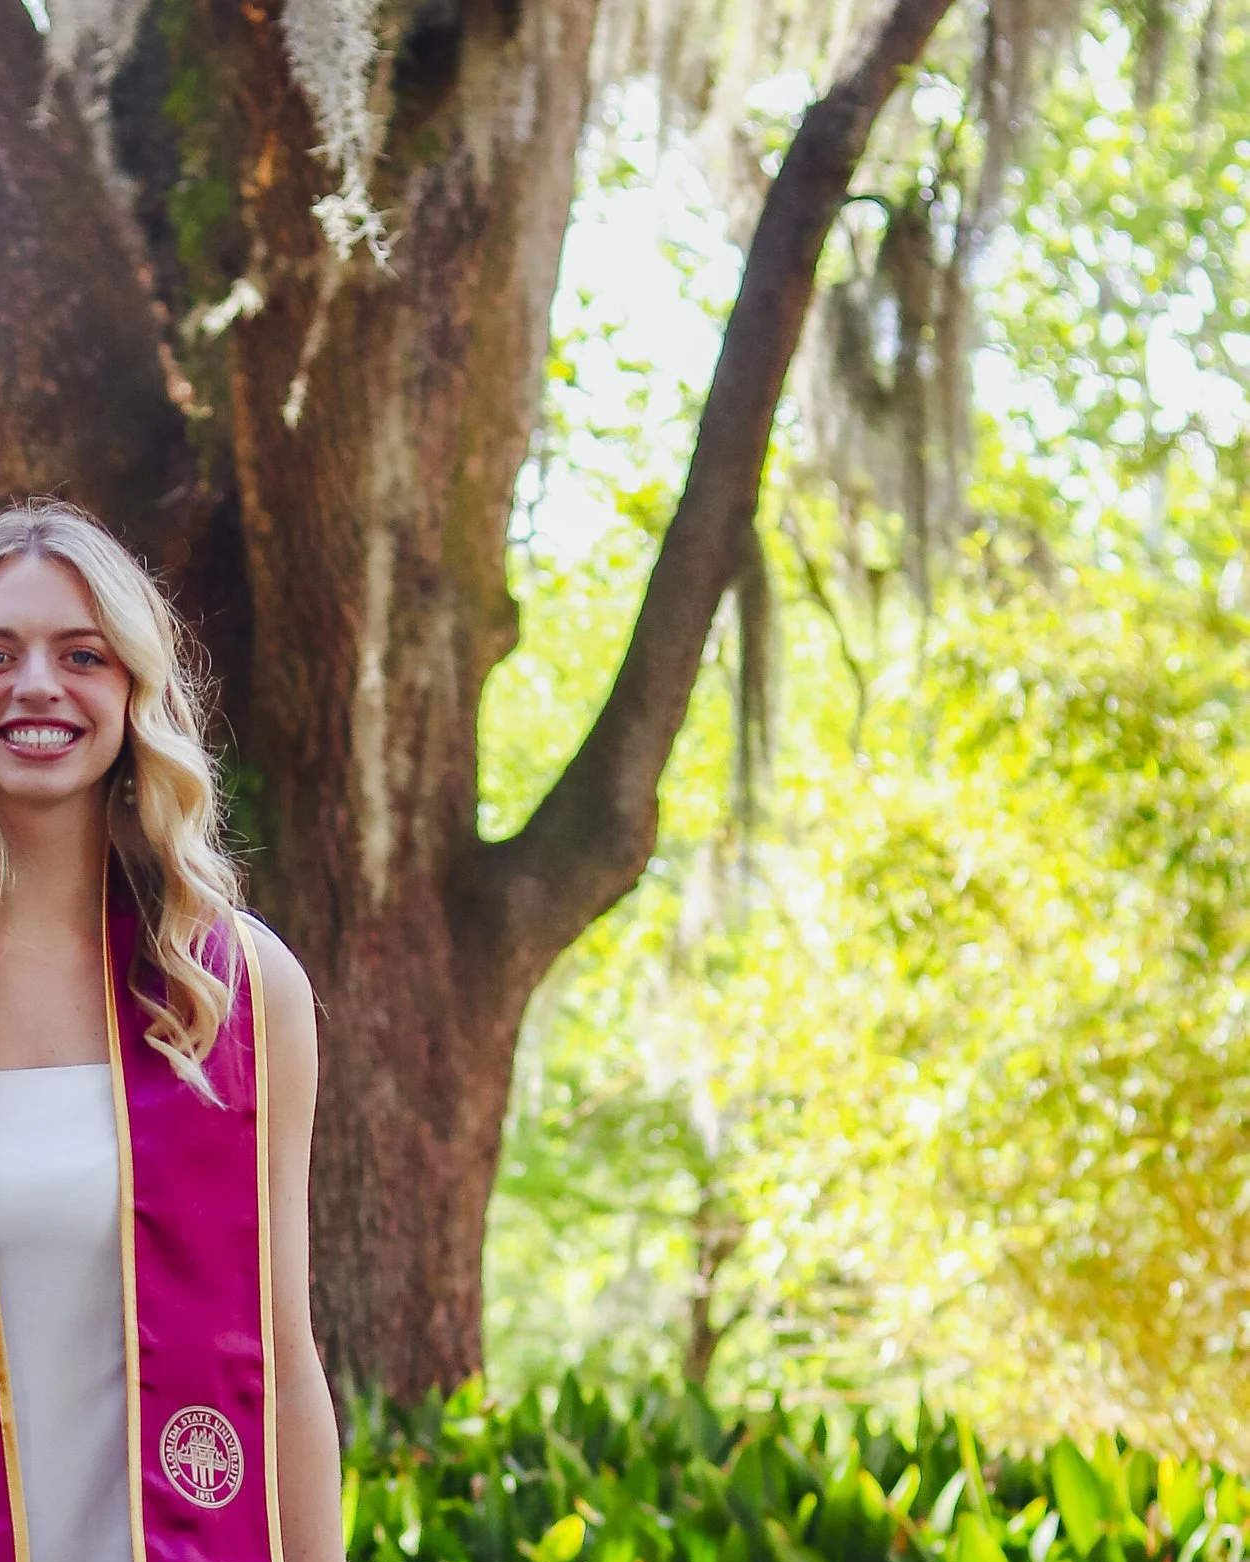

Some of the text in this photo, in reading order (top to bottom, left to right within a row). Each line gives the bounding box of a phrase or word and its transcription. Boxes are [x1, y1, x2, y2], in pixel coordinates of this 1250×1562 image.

[166, 1412, 239, 1490] FLORIDA STATE UNIVERSITY
[195, 1489, 216, 1502] 1851
